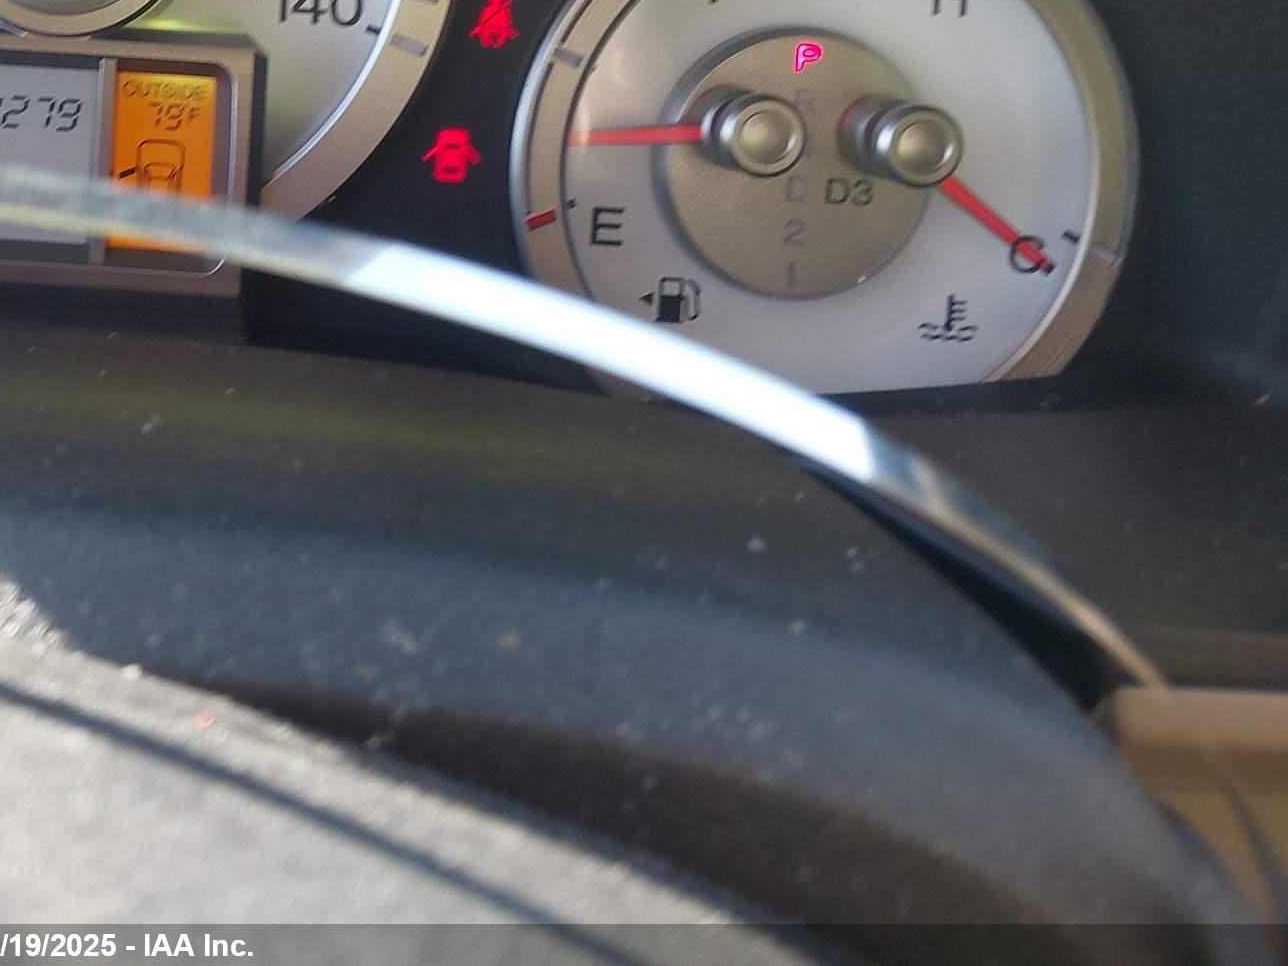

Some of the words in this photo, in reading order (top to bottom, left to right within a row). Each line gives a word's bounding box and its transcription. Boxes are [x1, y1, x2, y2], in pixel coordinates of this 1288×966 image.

[793, 42, 824, 73] P
[121, 79, 208, 101] OUTSIDE
[824, 177, 873, 206] D3
[590, 207, 624, 246] E
[784, 218, 805, 245] 2
[1009, 236, 1045, 273] C
